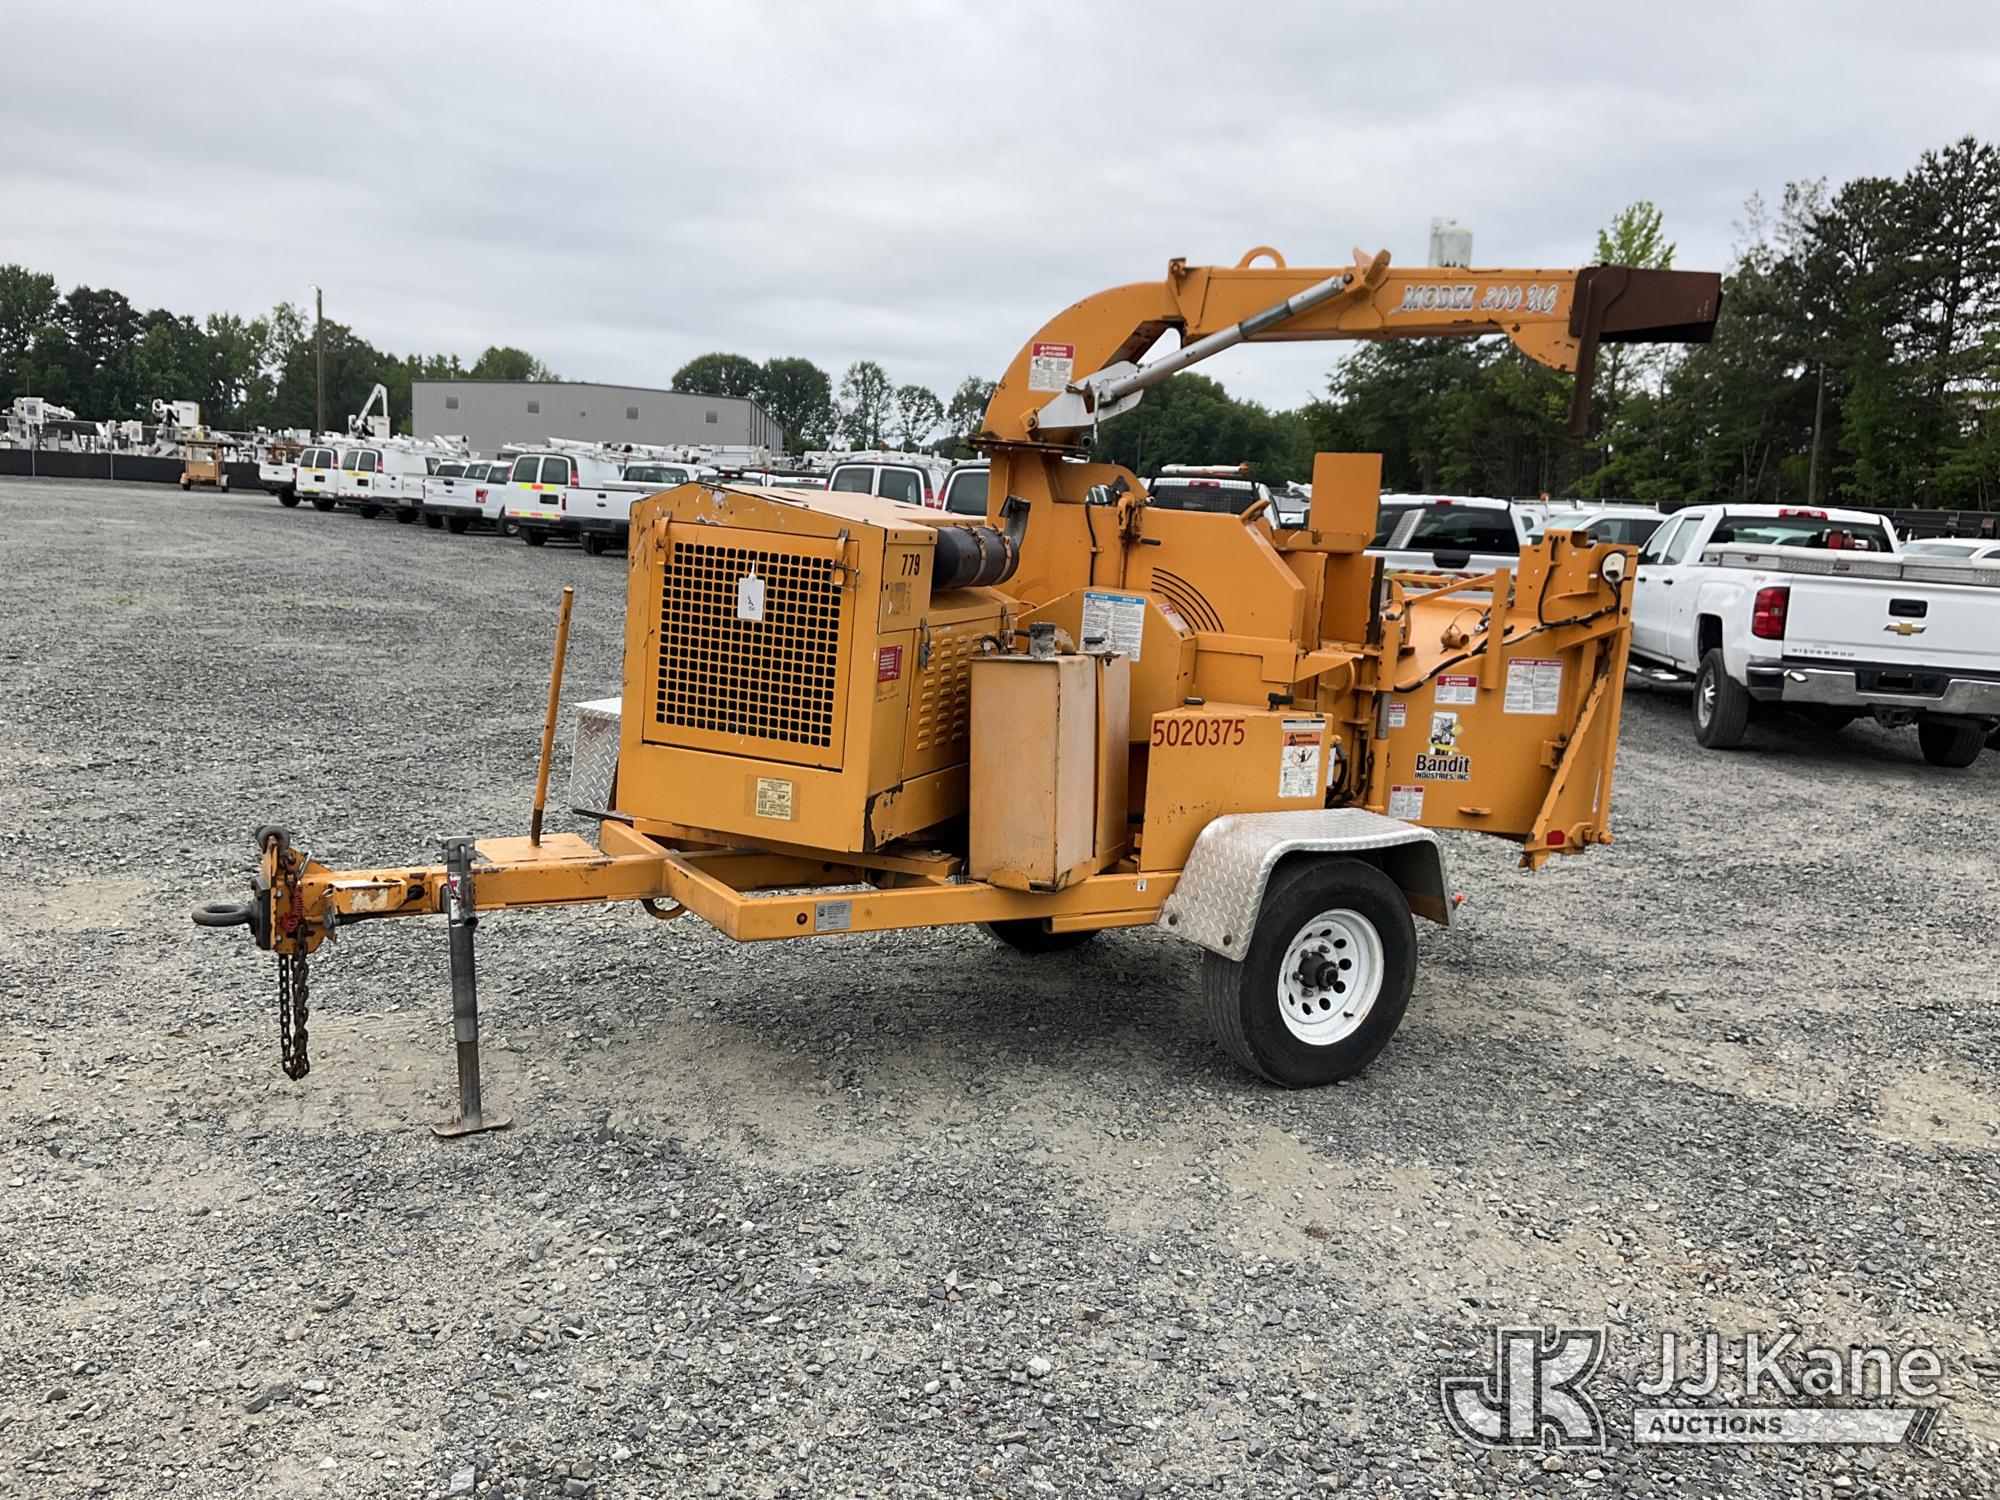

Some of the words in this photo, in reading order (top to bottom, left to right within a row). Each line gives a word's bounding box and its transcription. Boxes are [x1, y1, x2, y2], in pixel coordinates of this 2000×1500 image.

[1401, 284, 1476, 312] MODEL
[901, 553, 921, 576] 779
[1152, 719, 1246, 747] 5020375
[1415, 754, 1470, 773] Bandit
